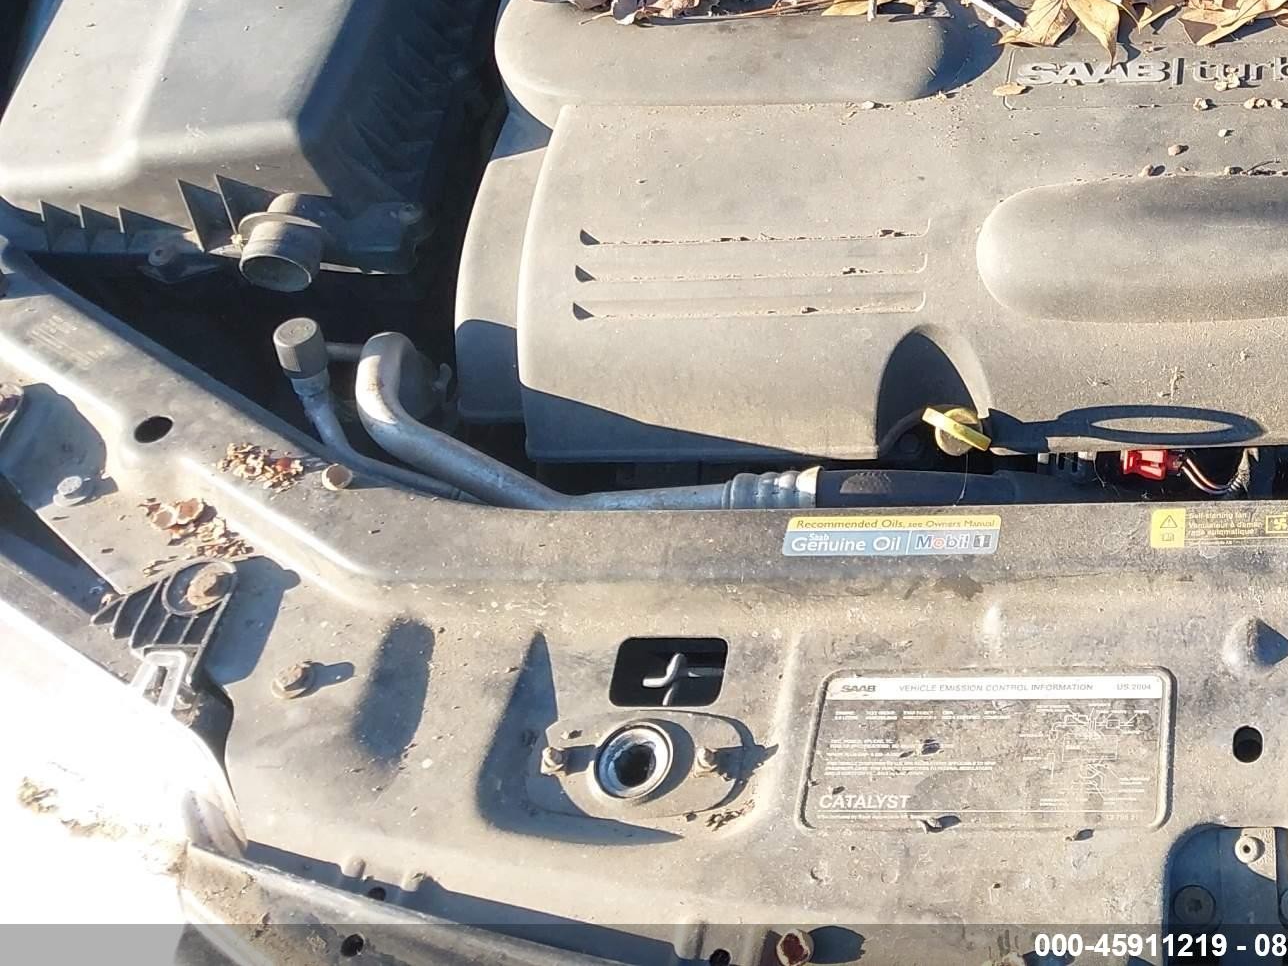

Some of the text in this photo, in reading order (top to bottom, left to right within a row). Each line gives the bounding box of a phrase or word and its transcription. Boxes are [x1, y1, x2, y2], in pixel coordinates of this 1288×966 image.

[1015, 60, 1170, 85] SAAB
[796, 519, 878, 529] Recommended
[881, 519, 905, 529] Oils,
[925, 520, 961, 528] Owners
[964, 519, 996, 528] Manual
[791, 535, 901, 553] Genuine Oil
[808, 532, 830, 542] Saab
[914, 534, 970, 550] Mobil
[841, 684, 877, 693] SAAB
[899, 684, 937, 692] VEHICLE
[939, 684, 983, 692] EMISSION
[985, 683, 1029, 691] CONTROL
[1031, 683, 1094, 691] INFORMATION
[819, 794, 911, 809] CATALYST
